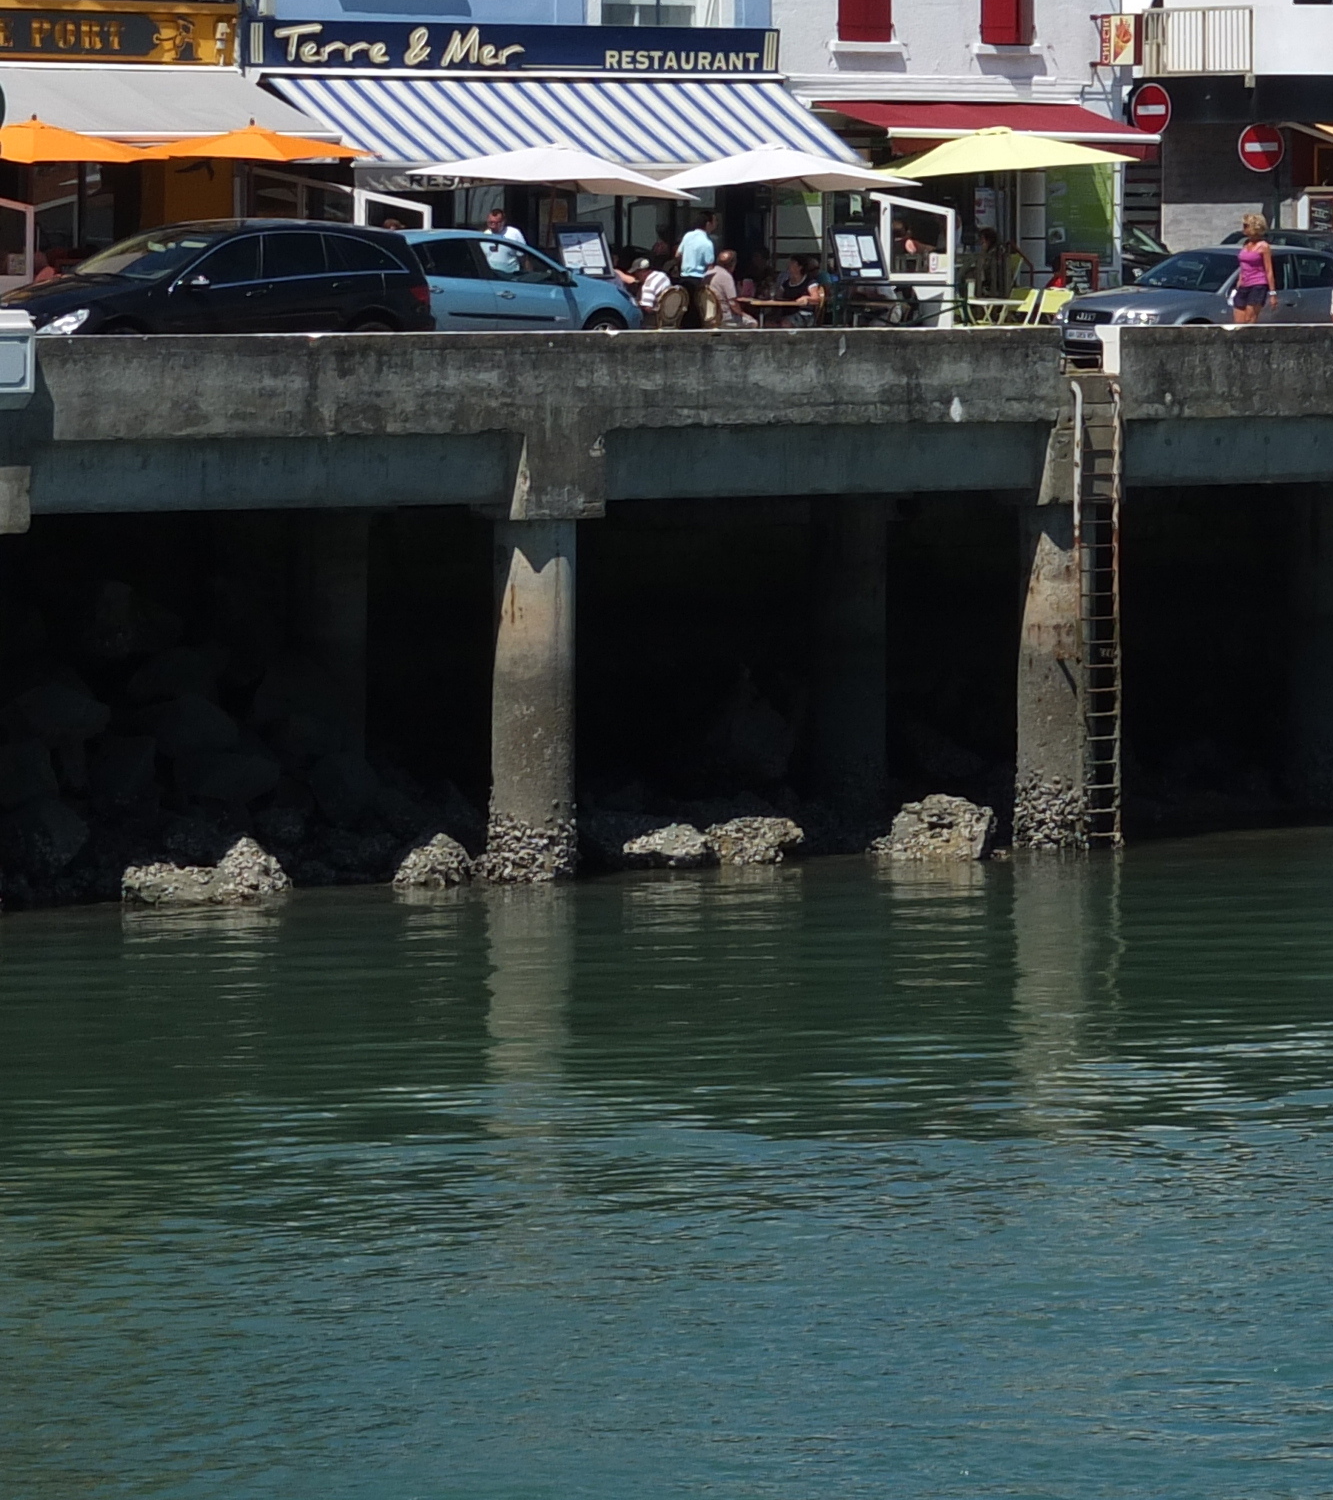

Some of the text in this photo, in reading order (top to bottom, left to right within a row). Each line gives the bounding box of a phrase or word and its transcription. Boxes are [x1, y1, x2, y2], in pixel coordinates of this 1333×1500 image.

[31, 18, 125, 50] PORT
[274, 22, 526, 67] Terre & Mer
[604, 49, 760, 72] RESTAURANT
